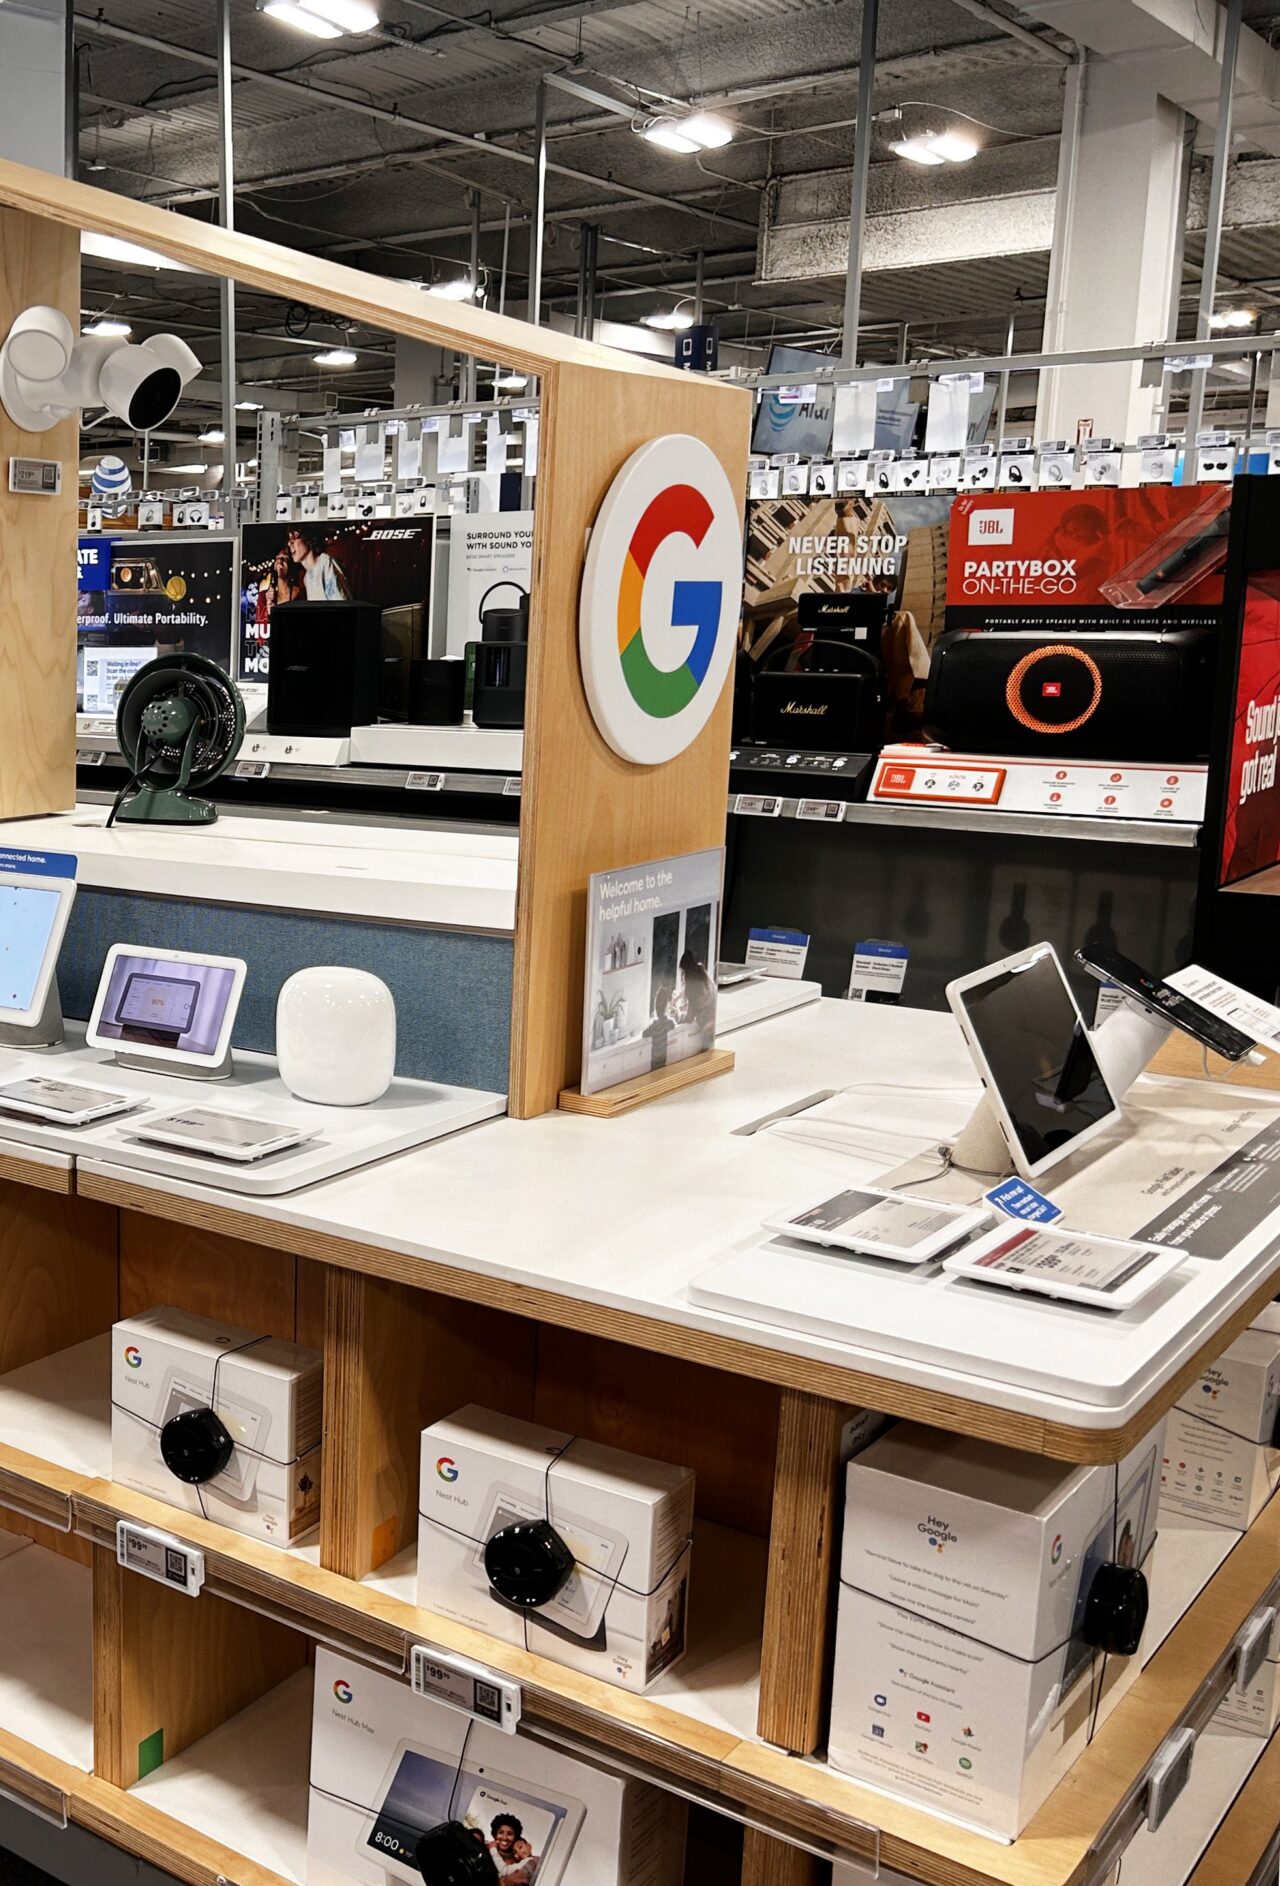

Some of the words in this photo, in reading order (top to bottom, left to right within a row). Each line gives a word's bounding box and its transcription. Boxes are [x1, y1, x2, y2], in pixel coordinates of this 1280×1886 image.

[362, 528, 422, 541] BOSE
[466, 531, 512, 540] SURROUND
[978, 520, 1004, 535] JBL
[466, 542, 488, 550] WITH
[489, 541, 518, 550] SOUND
[519, 540, 532, 549] YO
[788, 536, 850, 555] NEVER
[855, 535, 907, 555] STOP
[77, 548, 99, 565] ATE
[795, 557, 896, 576] LISTENING
[963, 559, 1077, 578] PARTYBOX
[962, 577, 1077, 595] ON-THE-GO
[818, 603, 851, 614] Marshall
[77, 612, 111, 625] erproof.
[113, 612, 153, 624] Ultimate
[155, 612, 209, 627] Portability.
[245, 623, 271, 639] MU
[1045, 686, 1058, 694] JBL
[780, 701, 829, 716] Marshall
[1245, 698, 1274, 745] Sound
[890, 773, 906, 784] JBL
[1239, 750, 1259, 806] got
[1257, 745, 1278, 792] real
[27, 855, 47, 864] home.
[599, 879, 645, 899] Welcome
[646, 876, 655, 890] to
[657, 869, 673, 886] the
[599, 900, 633, 922] helpful
[633, 894, 663, 913] home.
[124, 1375, 138, 1385] Nest
[138, 1378, 151, 1390] Hub
[435, 1489, 453, 1502] Nest
[453, 1495, 470, 1507] Hub
[927, 1515, 949, 1531] Hey
[917, 1522, 958, 1543] Google
[909, 1672, 930, 1686] Google
[930, 1680, 956, 1695] Assistant
[331, 1708, 347, 1720] Nest
[347, 1715, 361, 1728] Hub
[361, 1721, 375, 1735] Max
[374, 1832, 399, 1851] 8:00
